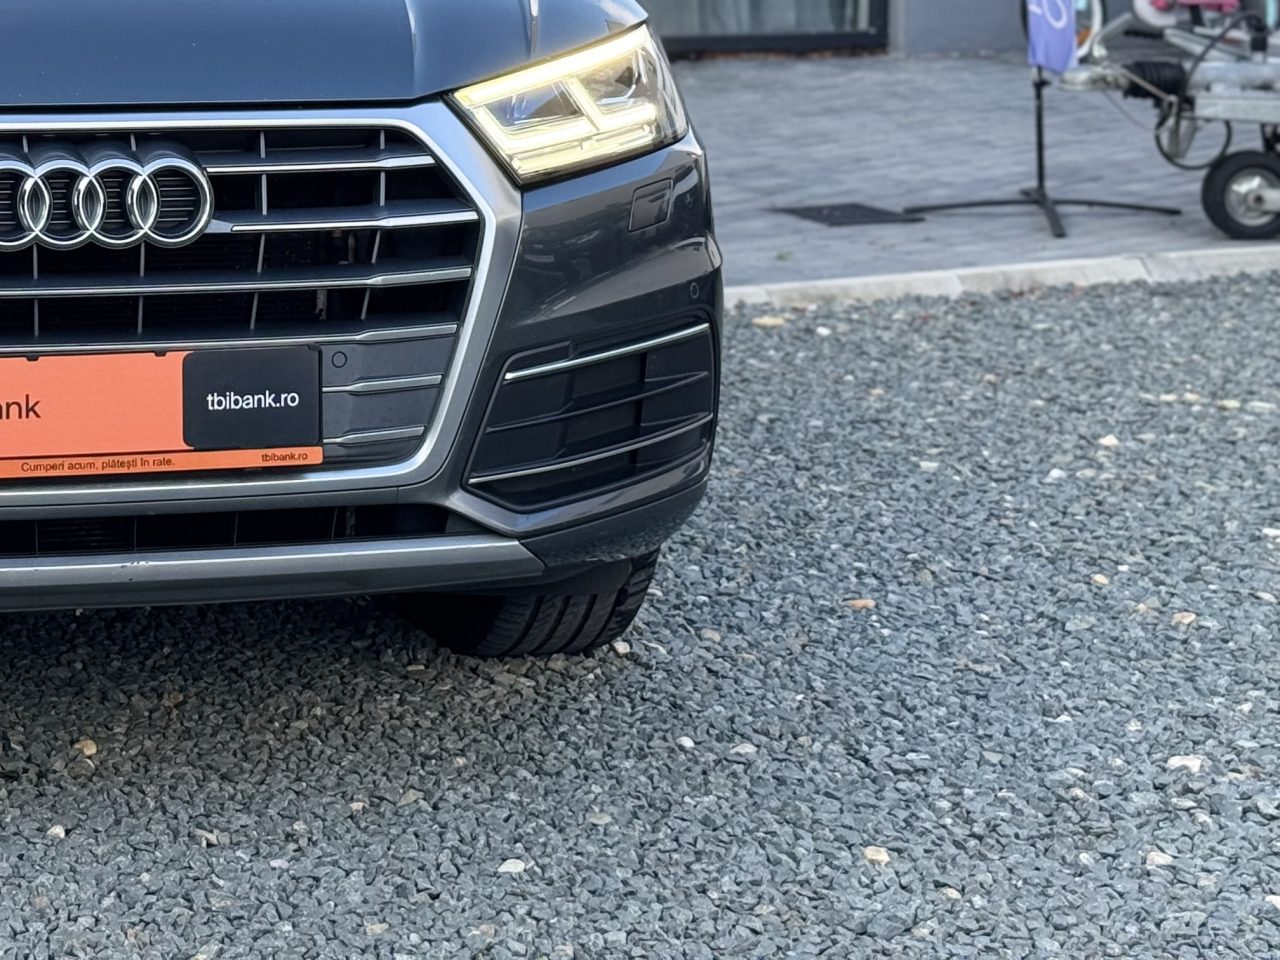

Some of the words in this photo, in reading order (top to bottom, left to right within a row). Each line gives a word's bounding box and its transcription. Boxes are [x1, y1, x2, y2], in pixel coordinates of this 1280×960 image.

[206, 390, 300, 411] tbibank.ro
[261, 452, 308, 462] tbibank.ro
[21, 461, 65, 473] Cumperi
